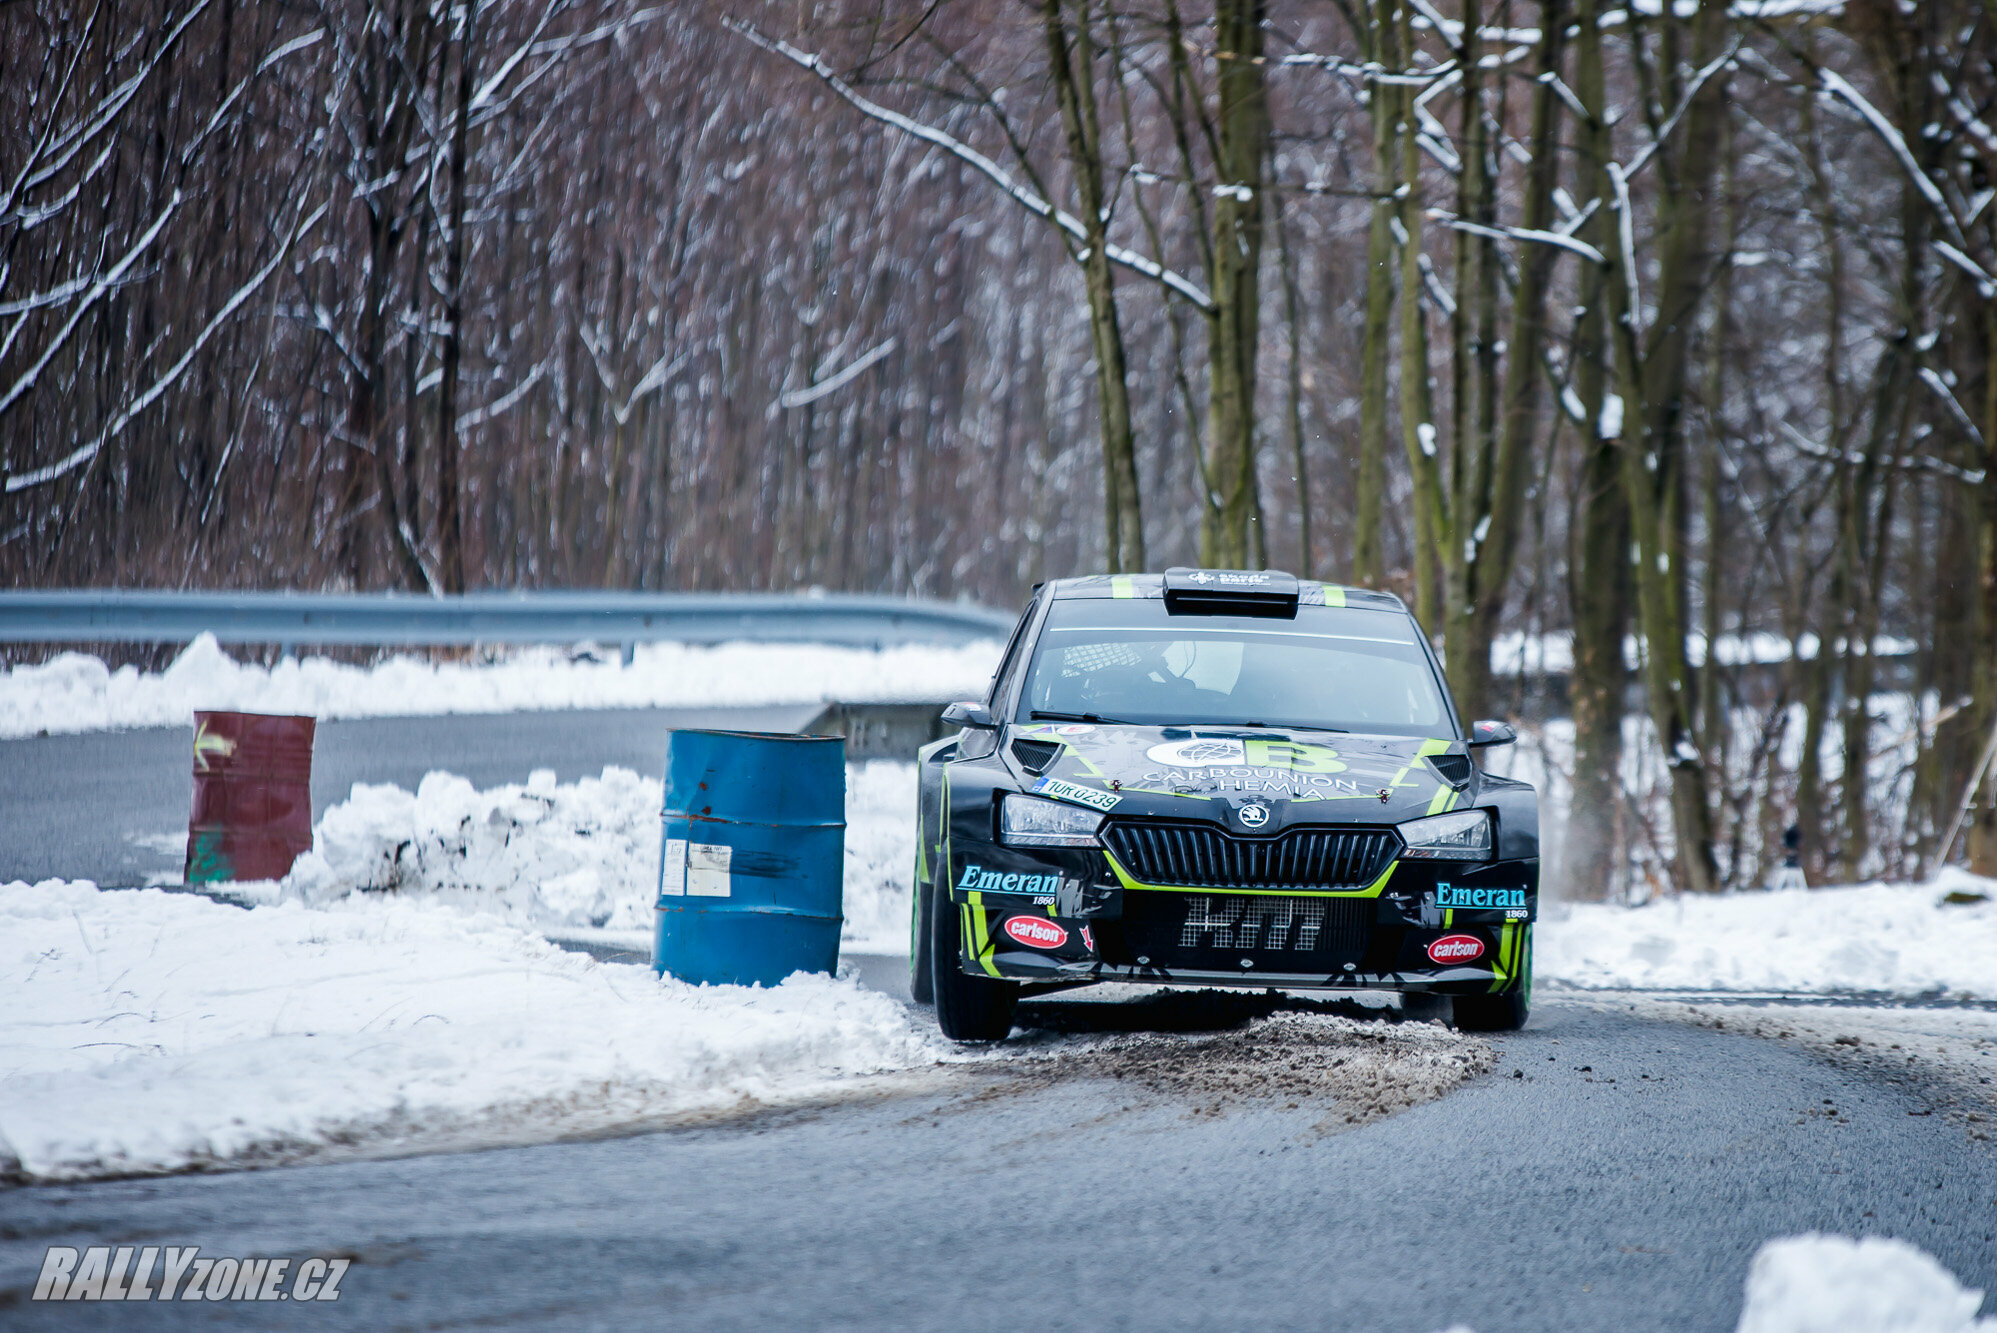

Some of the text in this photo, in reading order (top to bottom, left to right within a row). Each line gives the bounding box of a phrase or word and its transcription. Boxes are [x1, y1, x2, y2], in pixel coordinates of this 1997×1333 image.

[1142, 767, 1358, 791] CARBOUNION
[1074, 788, 1118, 808] 0239
[957, 864, 1060, 894] Emeran
[1032, 896, 1056, 906] 1860
[1435, 882, 1527, 907] Emeran
[1505, 909, 1529, 919] 1860
[1010, 921, 1060, 943] carlson
[1433, 940, 1480, 958] carlson
